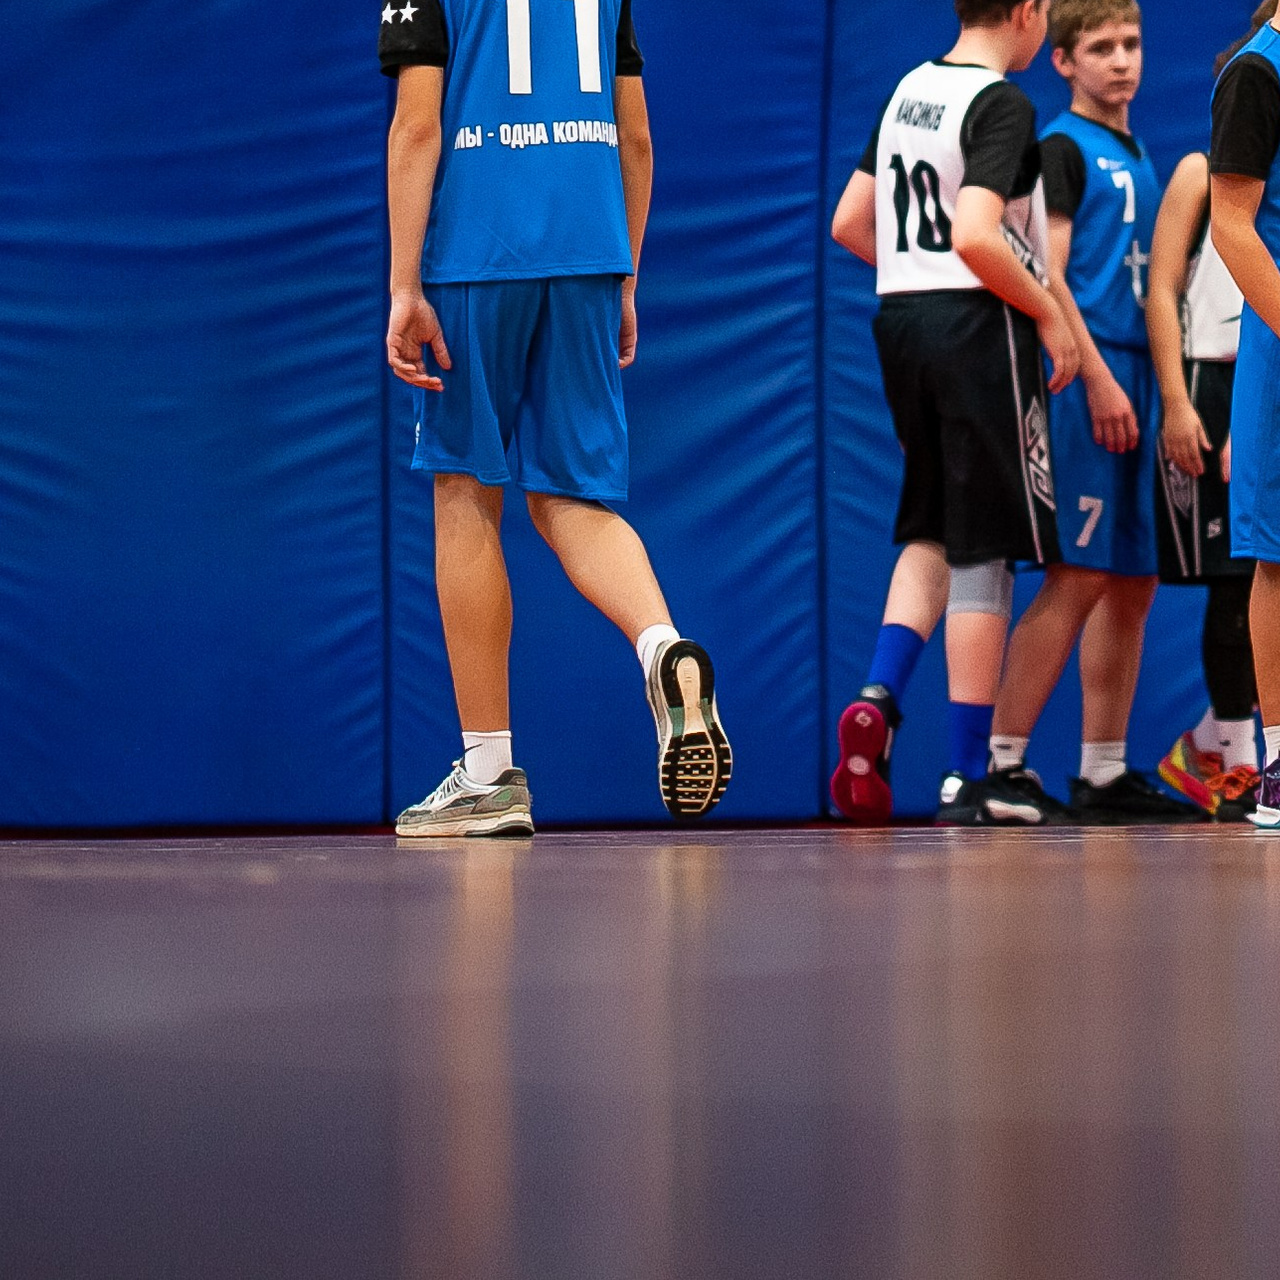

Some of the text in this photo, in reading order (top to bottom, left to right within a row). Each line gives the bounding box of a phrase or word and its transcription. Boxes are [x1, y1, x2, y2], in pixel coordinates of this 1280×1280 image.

[500, 122, 549, 149] ОДНА
[887, 153, 952, 253] 10
[1075, 495, 1104, 548] 7
